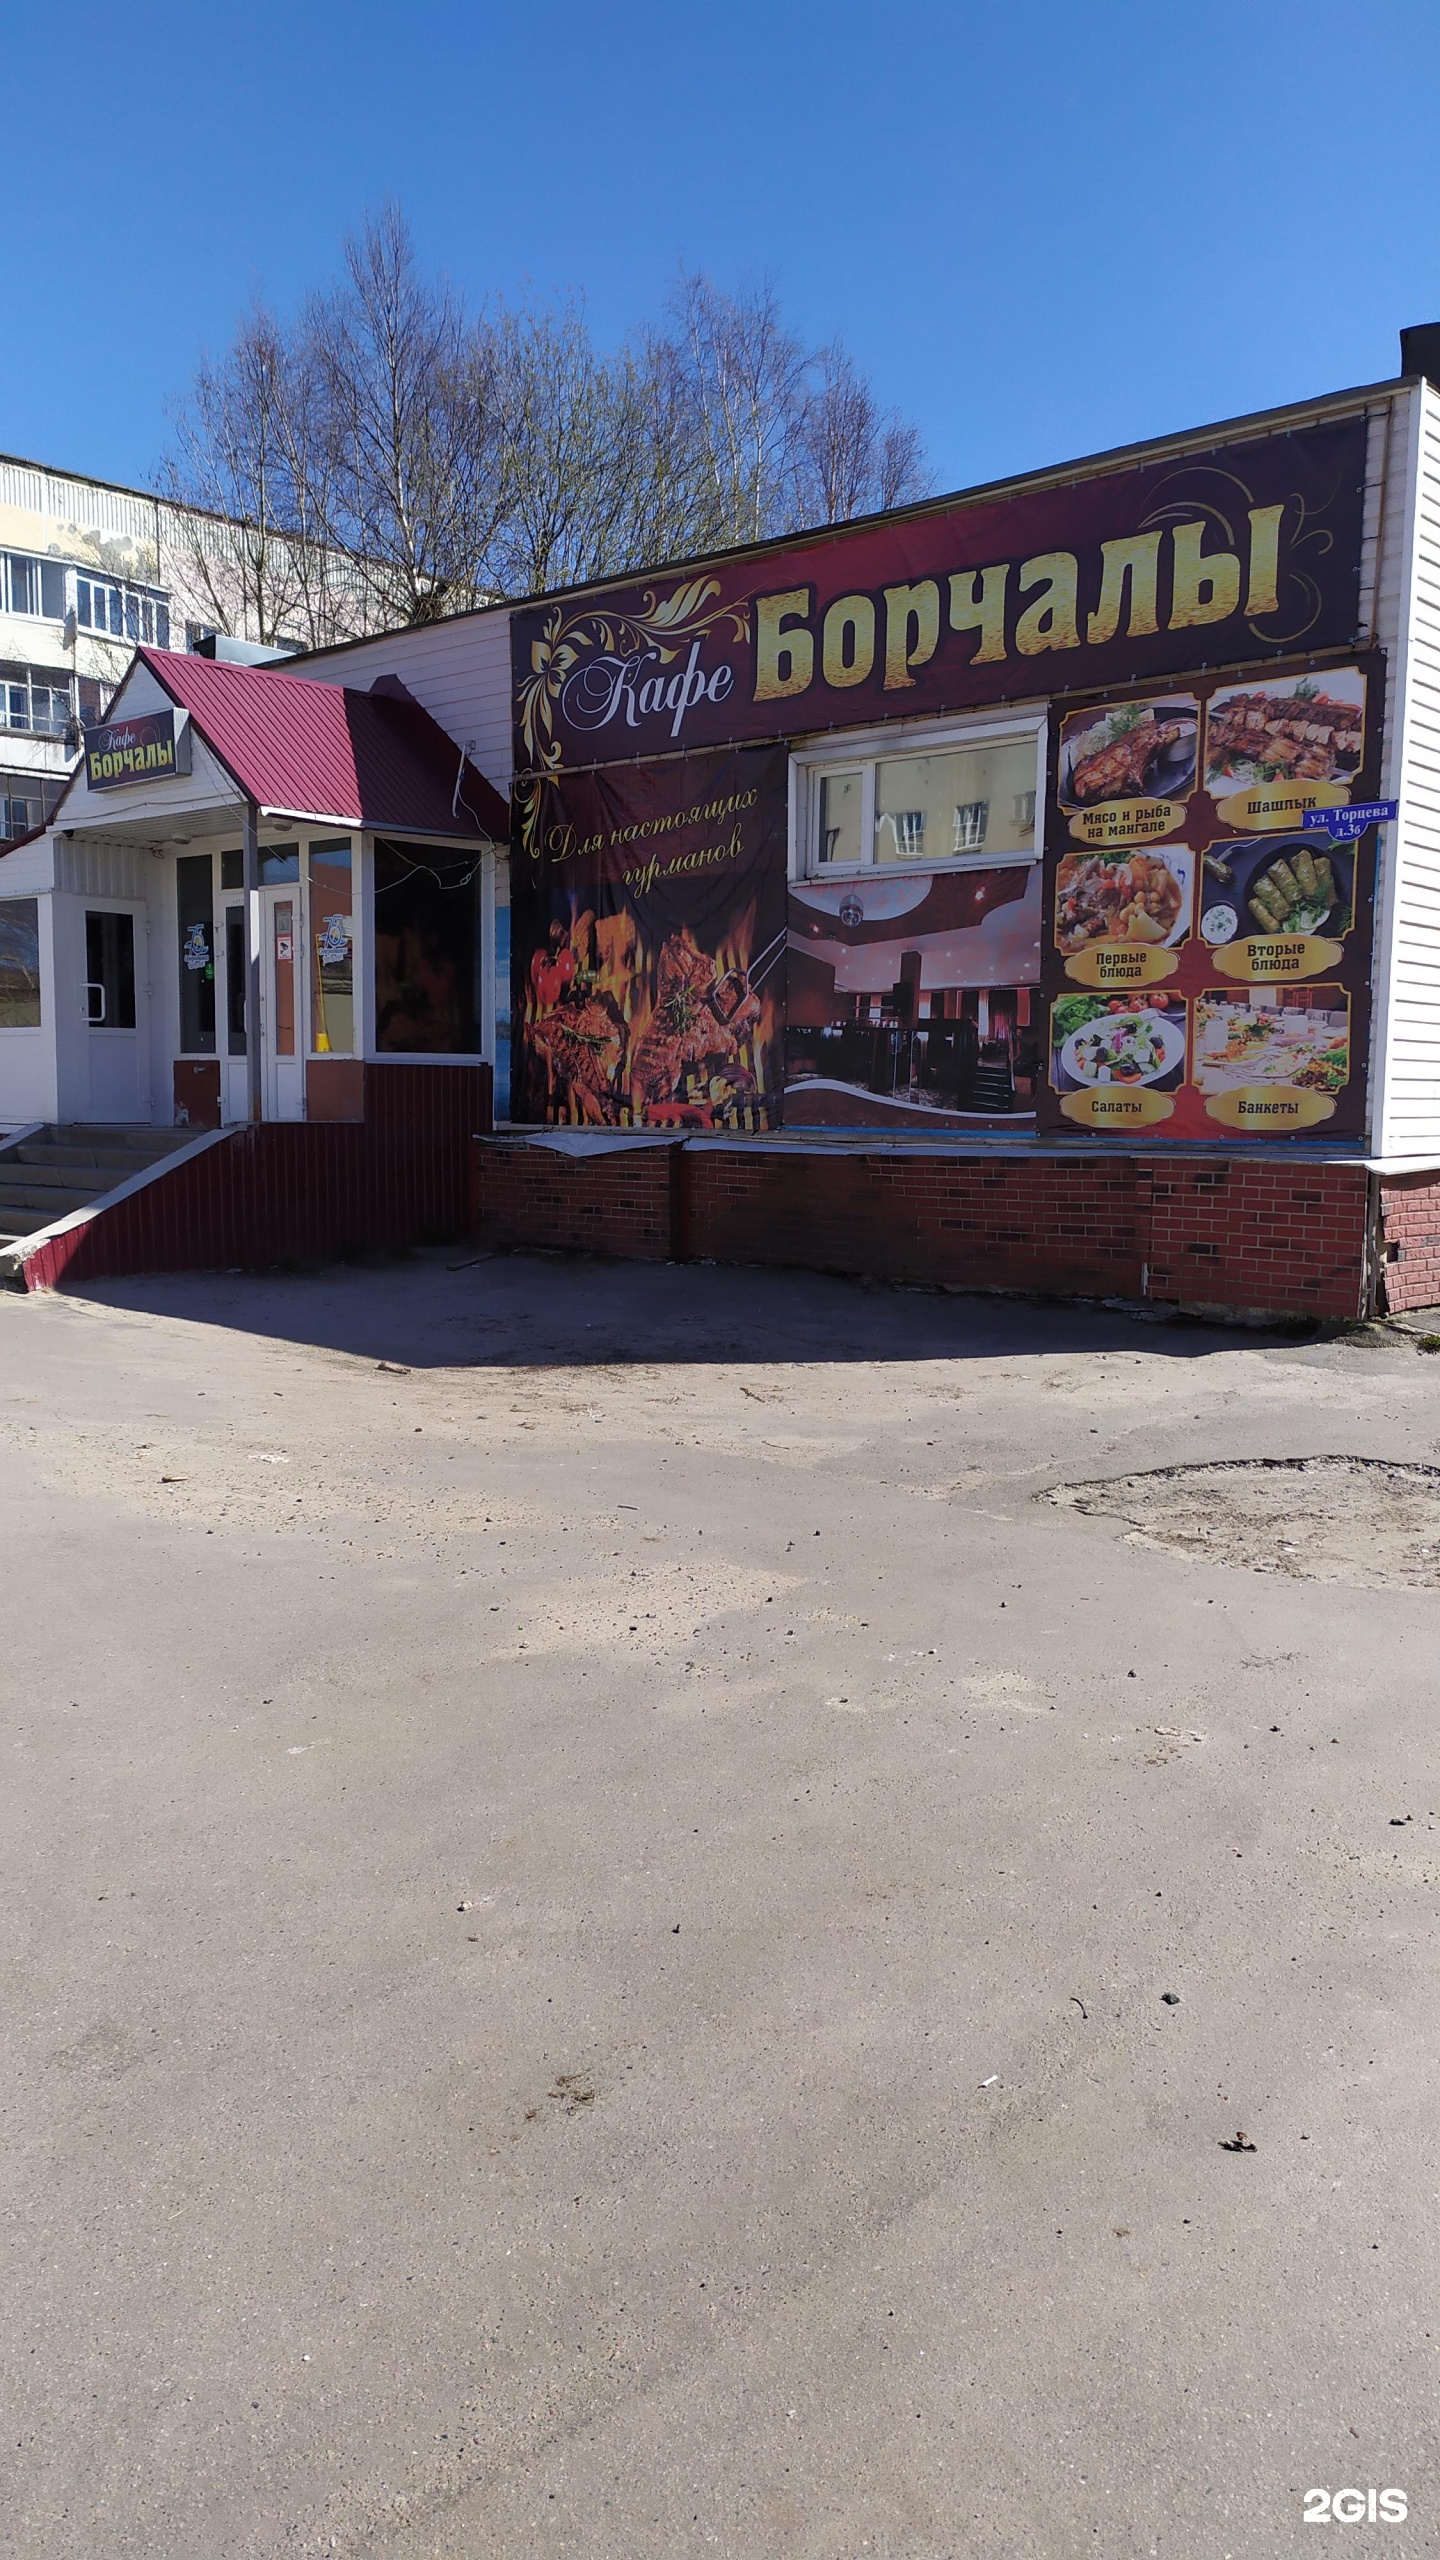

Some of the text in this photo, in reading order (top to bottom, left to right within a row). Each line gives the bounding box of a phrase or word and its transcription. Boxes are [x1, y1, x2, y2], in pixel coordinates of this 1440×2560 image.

[562, 503, 1285, 738] Кафе Борчалы
[89, 726, 174, 781] Кафе Борчалы
[1082, 804, 1172, 826] Мясо и рыба
[1246, 797, 1317, 815] Шашлык
[545, 788, 758, 863] Для настоящих
[1310, 806, 1389, 828] ул. Торцева
[1087, 820, 1166, 839] на мангале
[622, 823, 745, 899] гурманов
[1096, 952, 1147, 966] Первые
[1247, 943, 1306, 958] Вторые
[1100, 966, 1142, 979] блюда
[1251, 957, 1300, 972] блюда
[1091, 1100, 1143, 1113] Салаты
[1237, 1100, 1299, 1114] Банкеты
